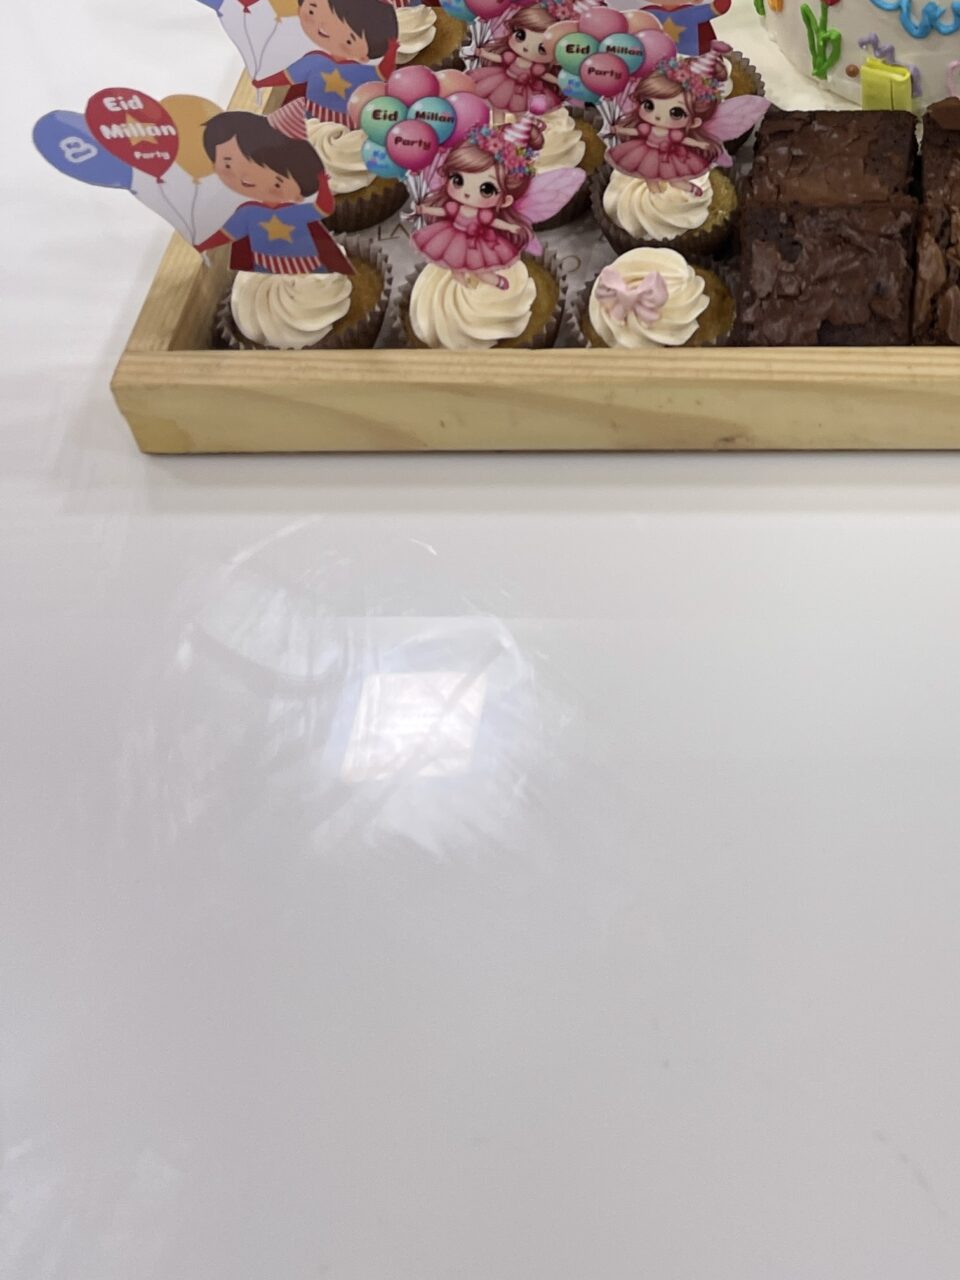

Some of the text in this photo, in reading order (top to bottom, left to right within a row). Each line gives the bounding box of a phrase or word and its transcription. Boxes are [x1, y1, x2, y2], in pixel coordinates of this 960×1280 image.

[566, 44, 643, 56] Eid Millan
[587, 67, 622, 80] Party
[102, 95, 144, 112] Eid
[372, 109, 455, 123] Eid Millan
[99, 124, 176, 140] Millan
[394, 136, 432, 151] Party
[133, 150, 170, 160] Party
